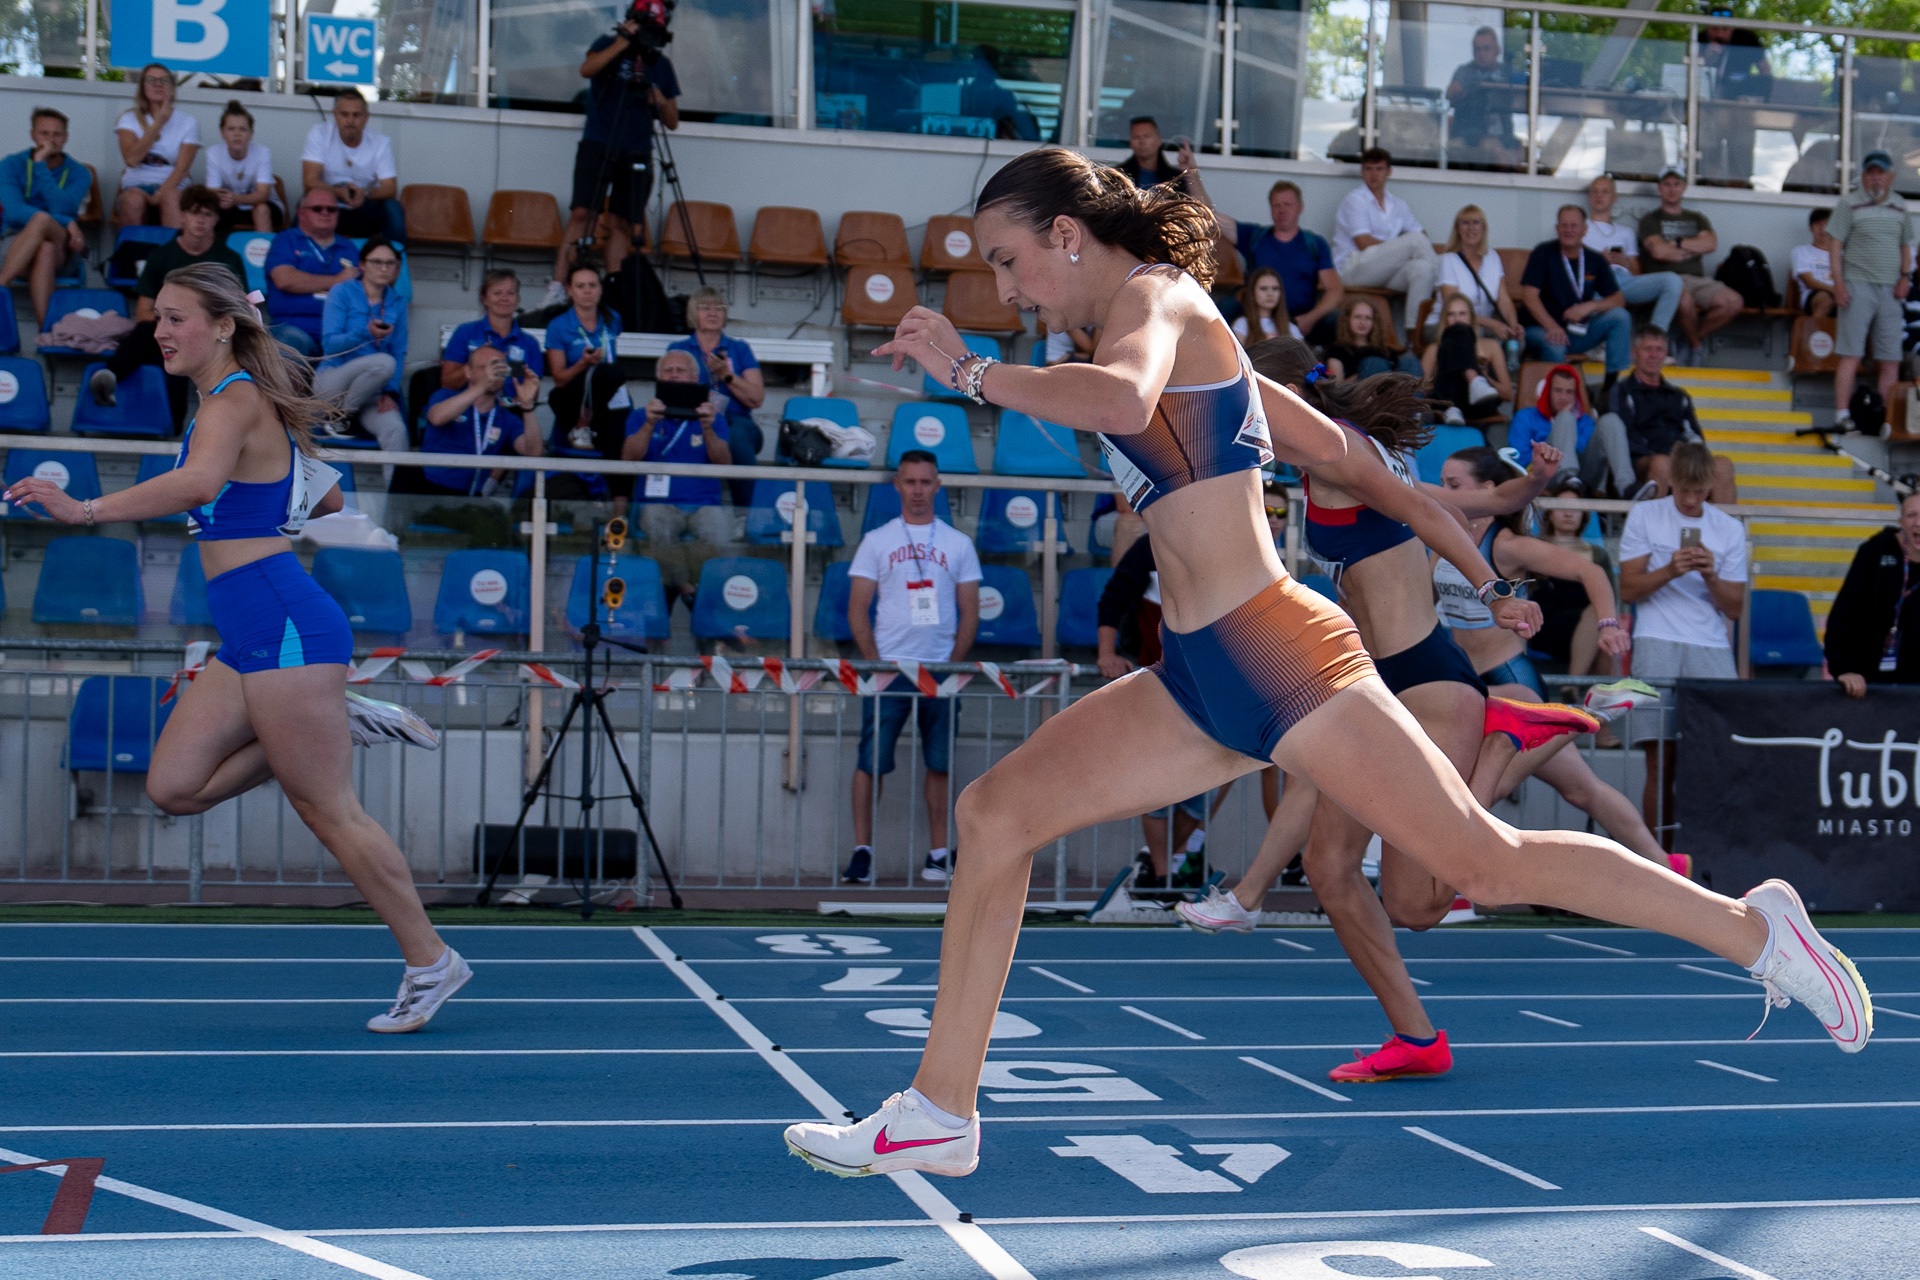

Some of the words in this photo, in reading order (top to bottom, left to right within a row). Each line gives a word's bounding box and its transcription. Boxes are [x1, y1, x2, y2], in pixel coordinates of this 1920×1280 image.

[152, 0, 229, 61] B
[312, 23, 372, 58] WC
[888, 543, 950, 573] POLSKA
[1435, 581, 1479, 600] SOBCZYŃSK
[1817, 818, 1912, 836] MIASTO
[755, 933, 893, 956] 8
[978, 1059, 1163, 1103] 5
[1048, 1134, 1293, 1194] 4
